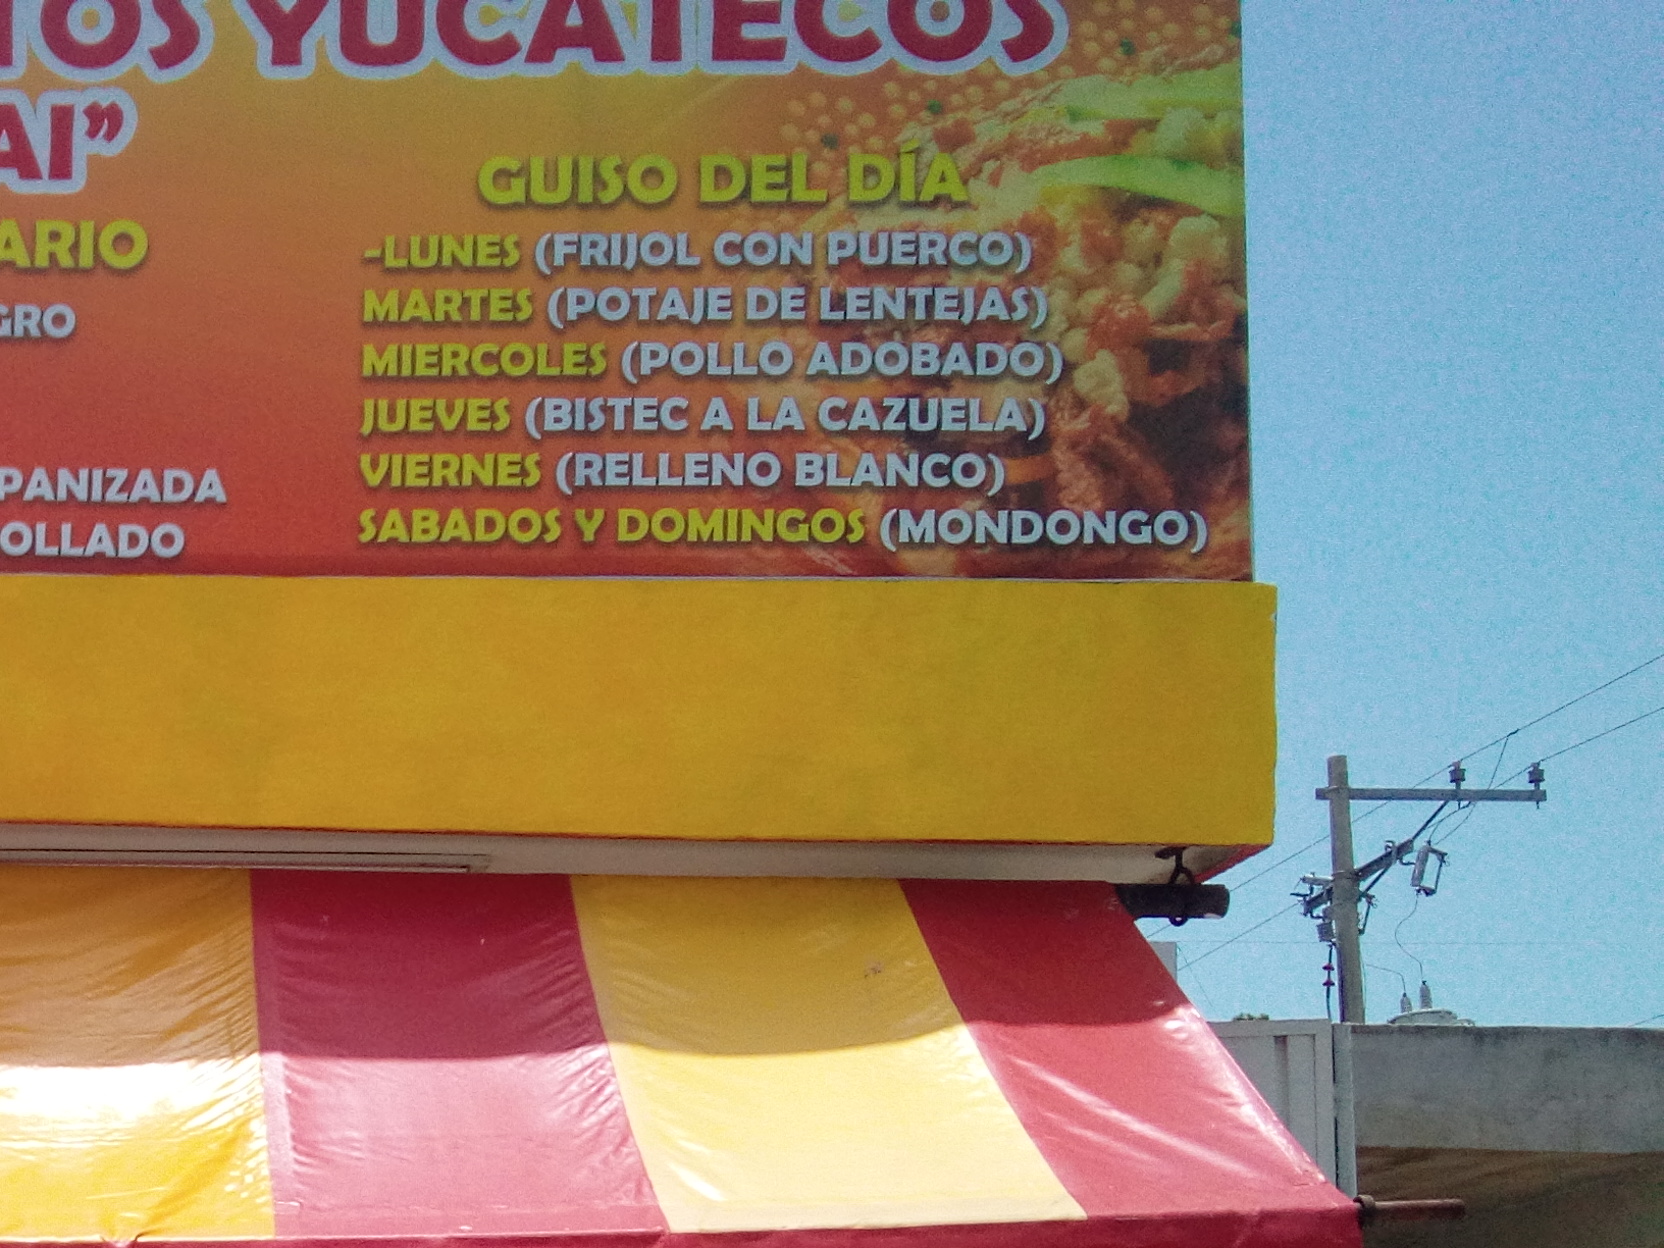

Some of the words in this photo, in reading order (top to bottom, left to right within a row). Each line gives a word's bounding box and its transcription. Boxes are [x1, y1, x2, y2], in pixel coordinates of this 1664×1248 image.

[476, 154, 679, 206] GUISO
[698, 152, 829, 204] DEL
[847, 138, 971, 204] DÍA
[363, 233, 522, 270] -LUNES
[533, 231, 701, 275] (FRIJOL
[712, 231, 814, 268] CON
[827, 230, 1034, 274] PUERCO)
[361, 287, 534, 324] MARTES
[546, 286, 733, 329] (POTAJE
[745, 286, 807, 322] DE
[818, 286, 1049, 329] LENTEJAS)
[360, 342, 608, 378] MIERCOLES
[620, 341, 794, 385] (POLLO
[805, 341, 1065, 386] ADOBADO)
[359, 396, 512, 436] JUEVES
[524, 396, 690, 440] (BISTEC
[700, 396, 734, 432] A
[746, 396, 806, 432] LA
[817, 396, 1047, 441] CAZUELA)
[358, 451, 542, 489] VIERNES
[554, 451, 782, 496] (RELLENO
[794, 451, 1006, 497] BLANCO)
[357, 507, 562, 546] SABADOS
[574, 508, 605, 544] Y
[616, 507, 866, 546] DOMINGOS
[879, 507, 1208, 554] (MONDONGO)
